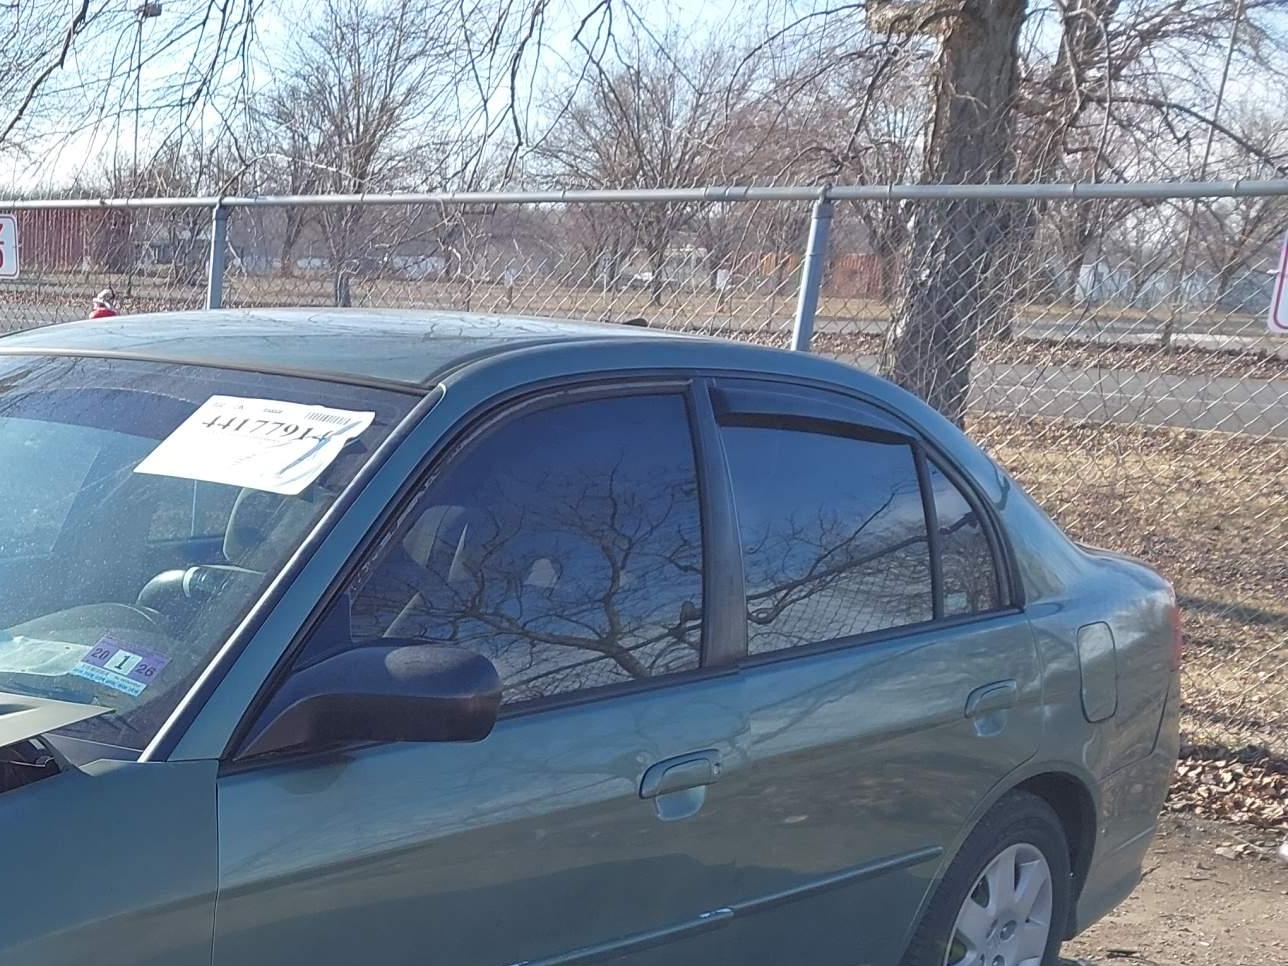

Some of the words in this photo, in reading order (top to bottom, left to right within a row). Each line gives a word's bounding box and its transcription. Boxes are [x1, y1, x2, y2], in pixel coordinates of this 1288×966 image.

[201, 414, 333, 442] 44177914
[91, 647, 111, 660] 20
[113, 654, 130, 670] 1
[135, 663, 157, 677] 26
